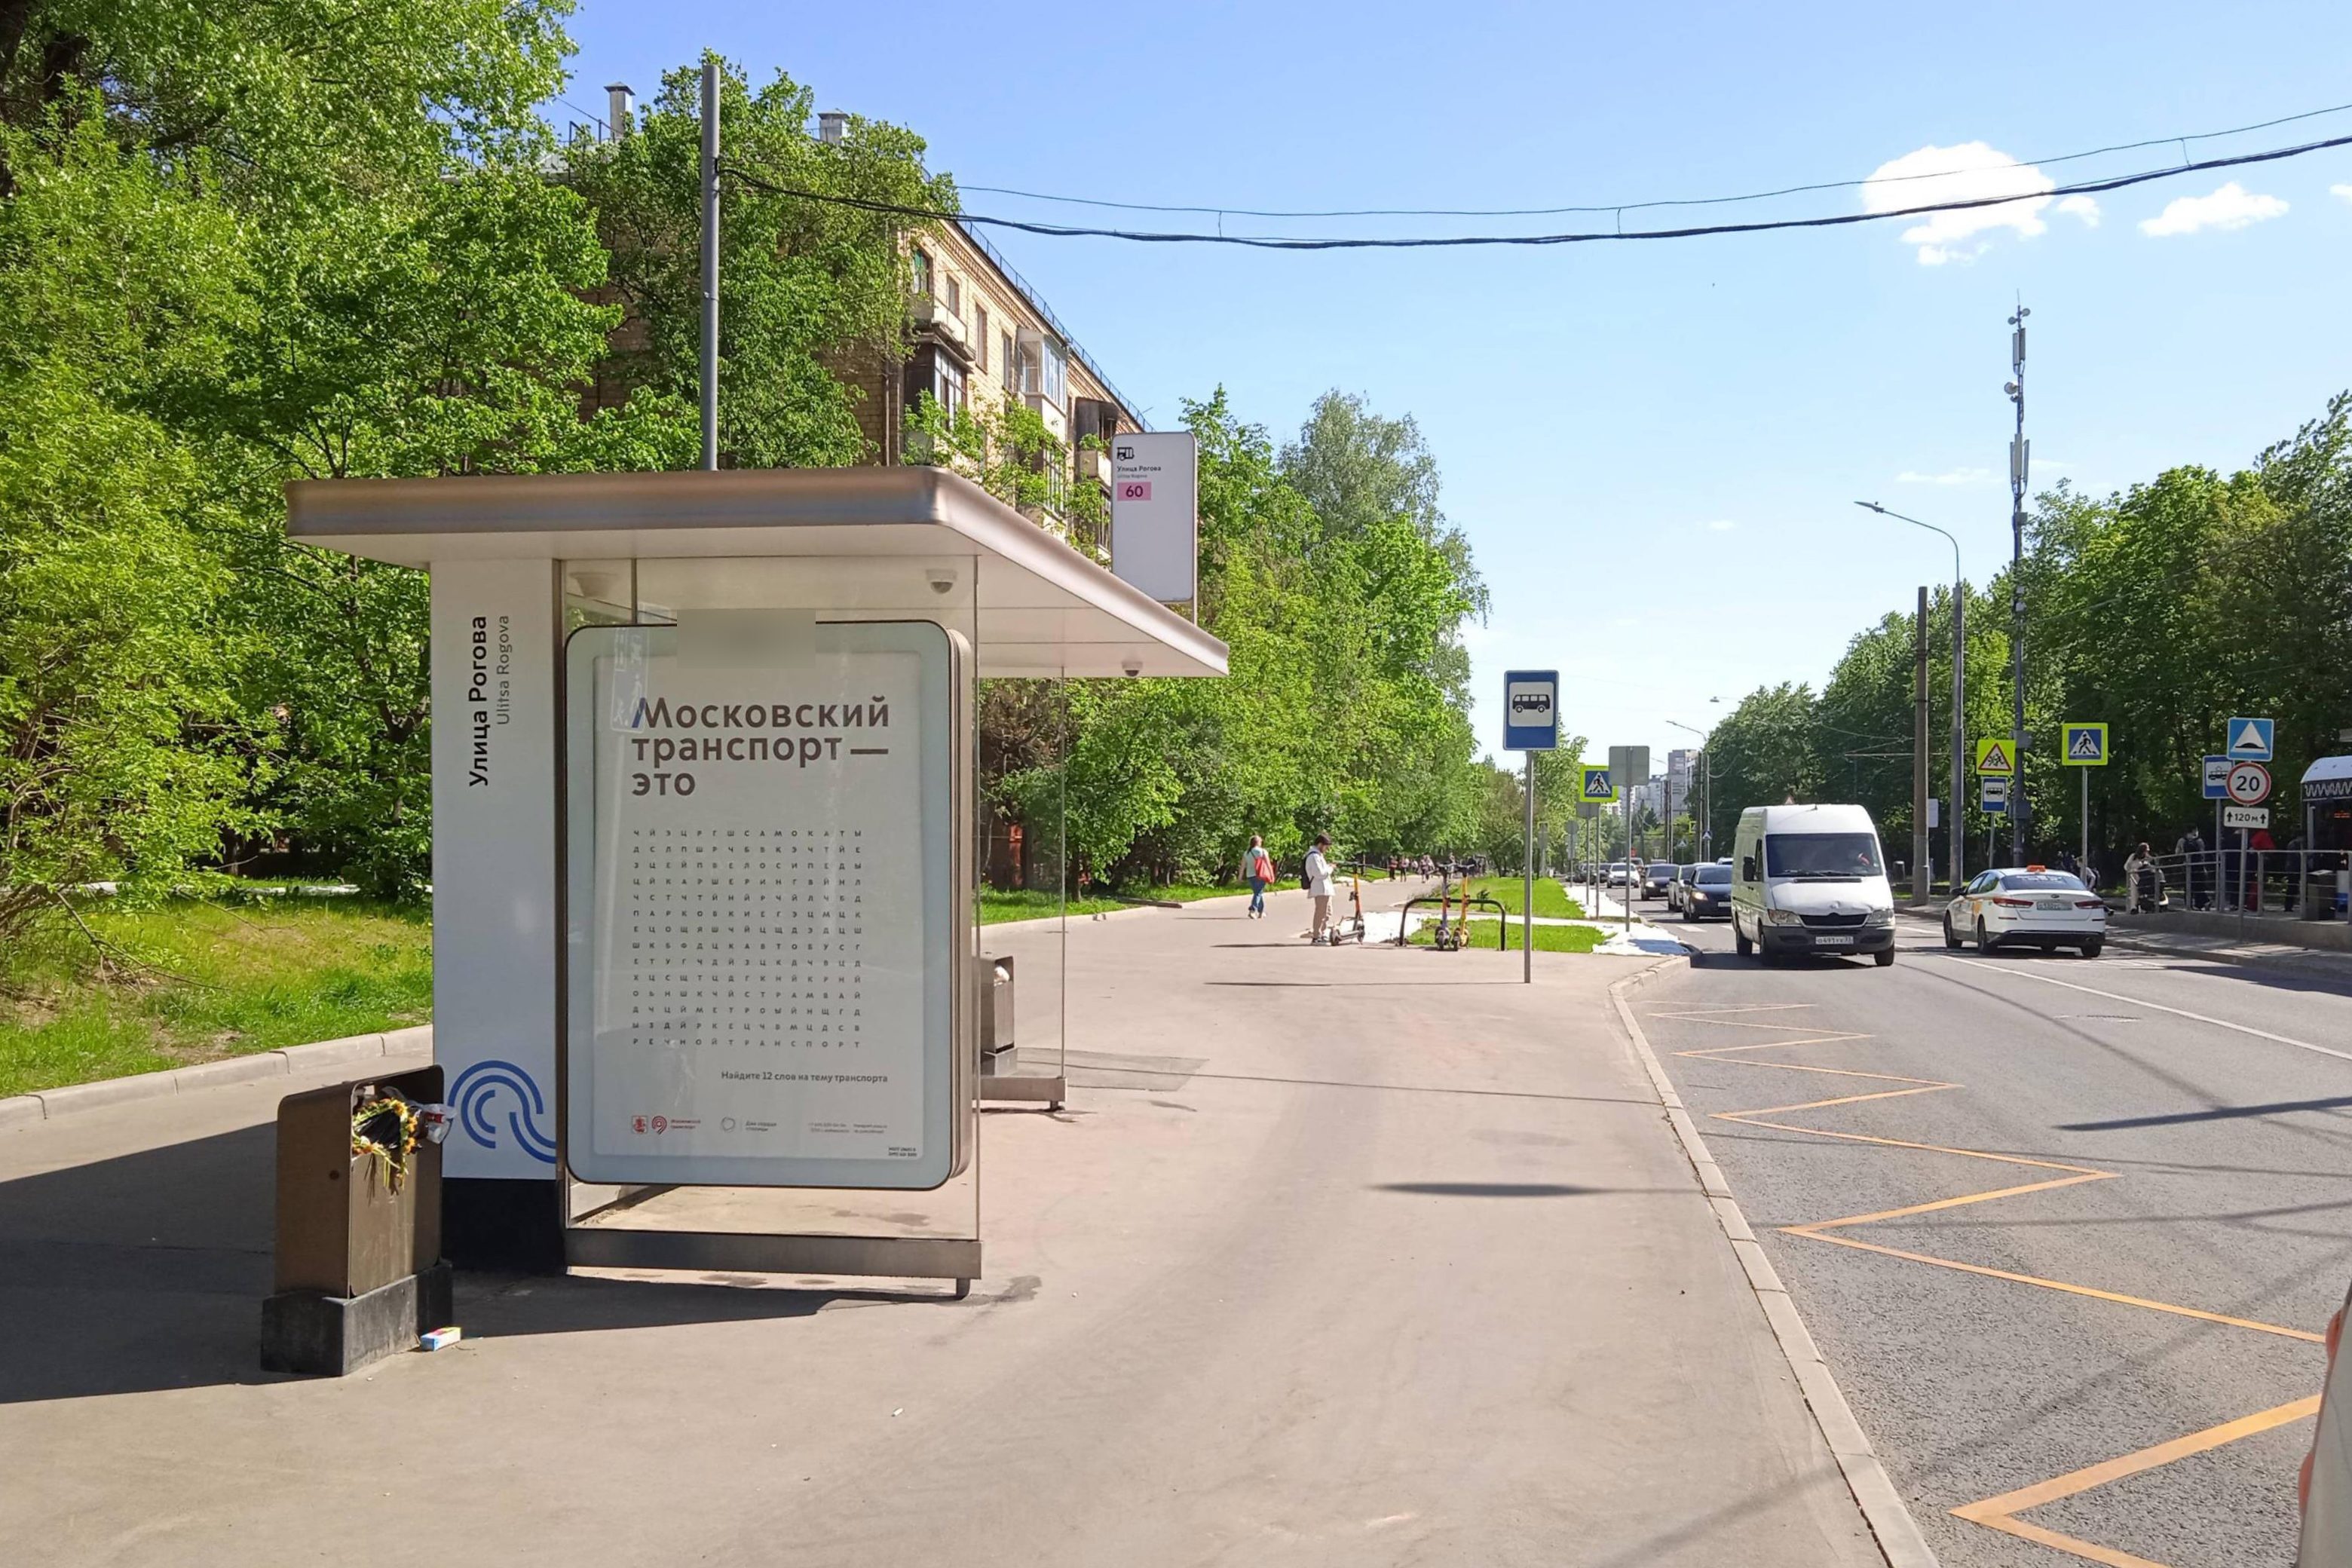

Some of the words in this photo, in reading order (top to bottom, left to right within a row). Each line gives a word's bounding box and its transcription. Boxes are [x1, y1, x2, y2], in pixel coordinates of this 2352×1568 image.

[1125, 485, 1144, 498] 60
[468, 616, 488, 703] Рогова
[495, 615, 513, 675] Rogova
[495, 680, 510, 725] Ulitsa
[631, 695, 889, 728] Московский
[468, 710, 491, 787] Улица
[631, 737, 843, 768] транспорт
[631, 773, 696, 797] это
[2235, 775, 2260, 792] 20
[721, 1070, 761, 1081] Найдите
[761, 1071, 773, 1080] 12
[774, 1073, 796, 1081] слов
[810, 1074, 832, 1083] тему
[834, 1074, 888, 1084] транспорта
